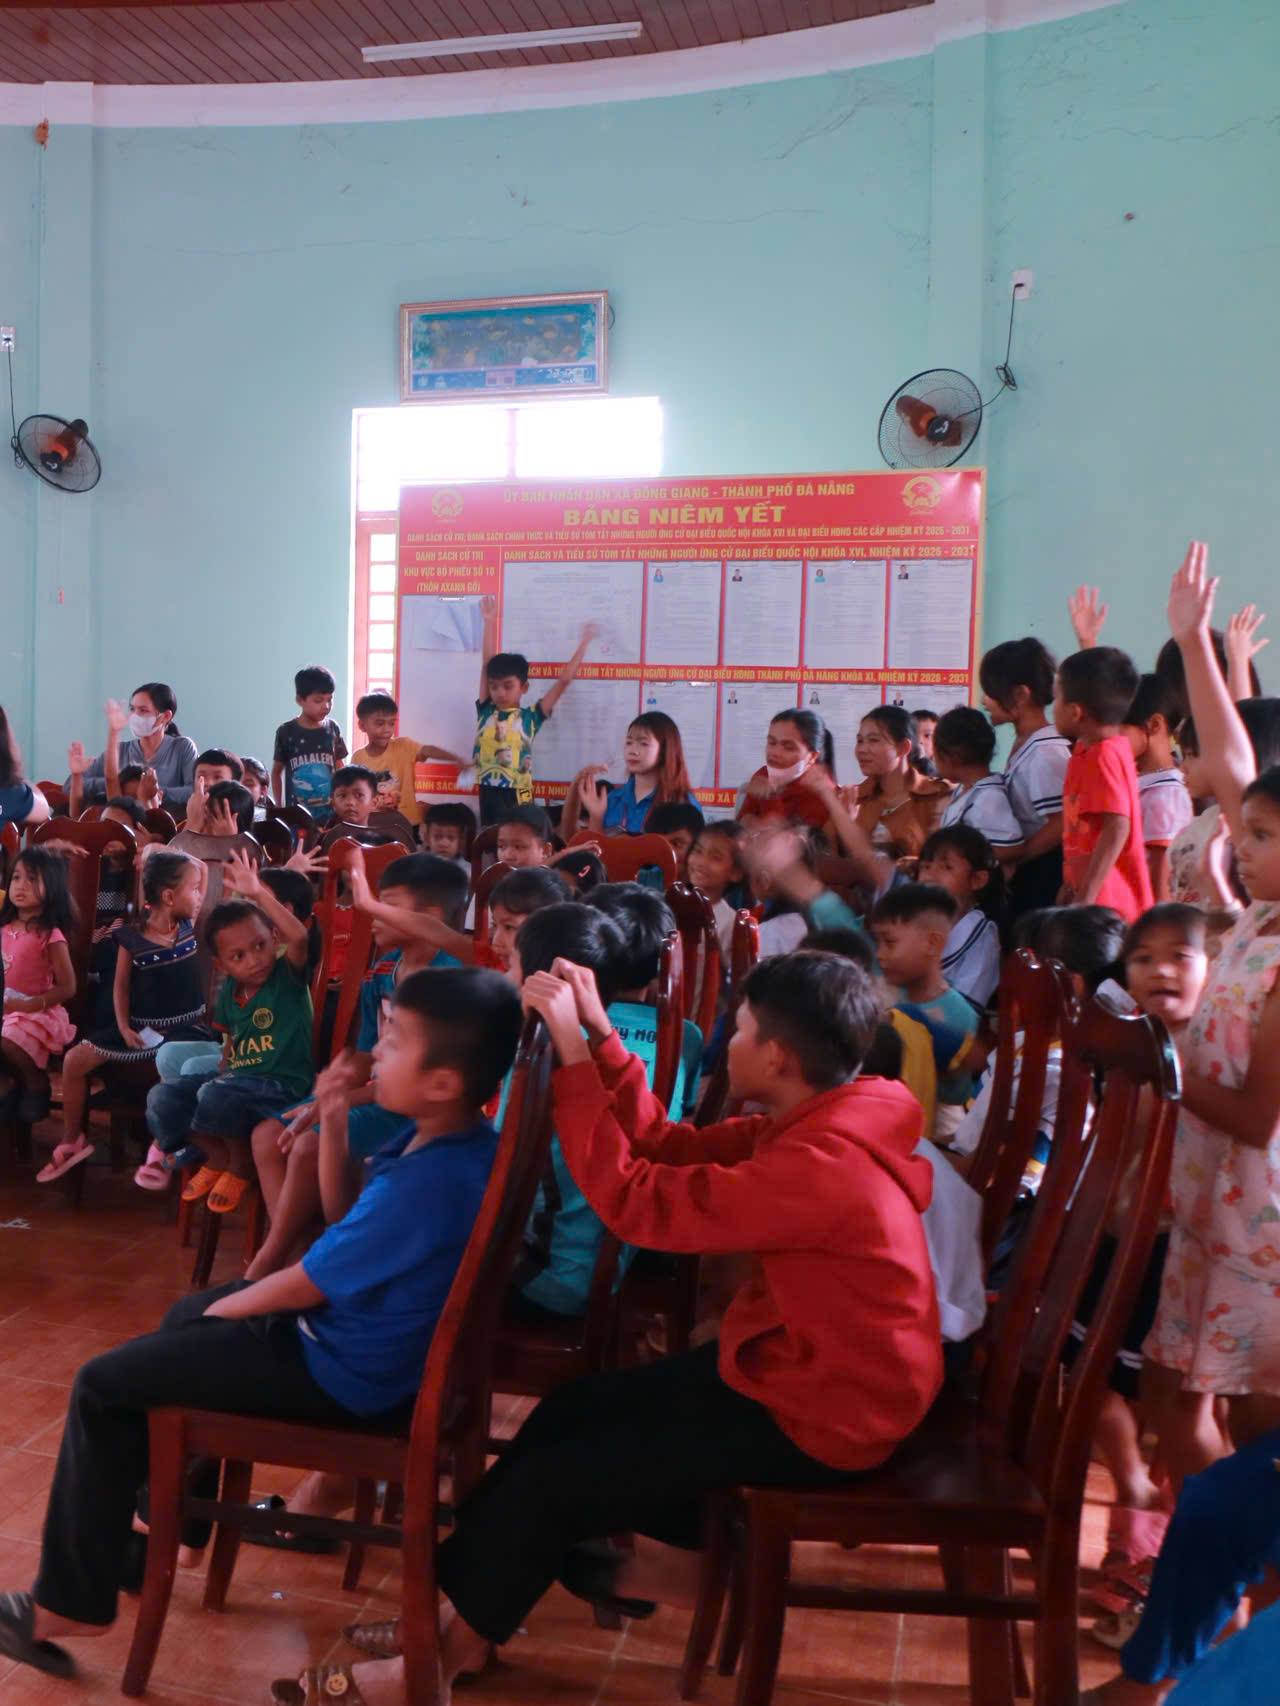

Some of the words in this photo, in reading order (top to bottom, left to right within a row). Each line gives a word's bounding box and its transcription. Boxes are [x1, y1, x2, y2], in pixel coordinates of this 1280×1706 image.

[671, 486, 709, 498] GIANG
[720, 483, 763, 497] THÀNH
[767, 481, 793, 497] PHỐ
[796, 483, 814, 496] ĐÀ
[563, 503, 639, 526] BẢNG
[649, 503, 723, 524] NIÊM
[734, 500, 785, 523] YẾT
